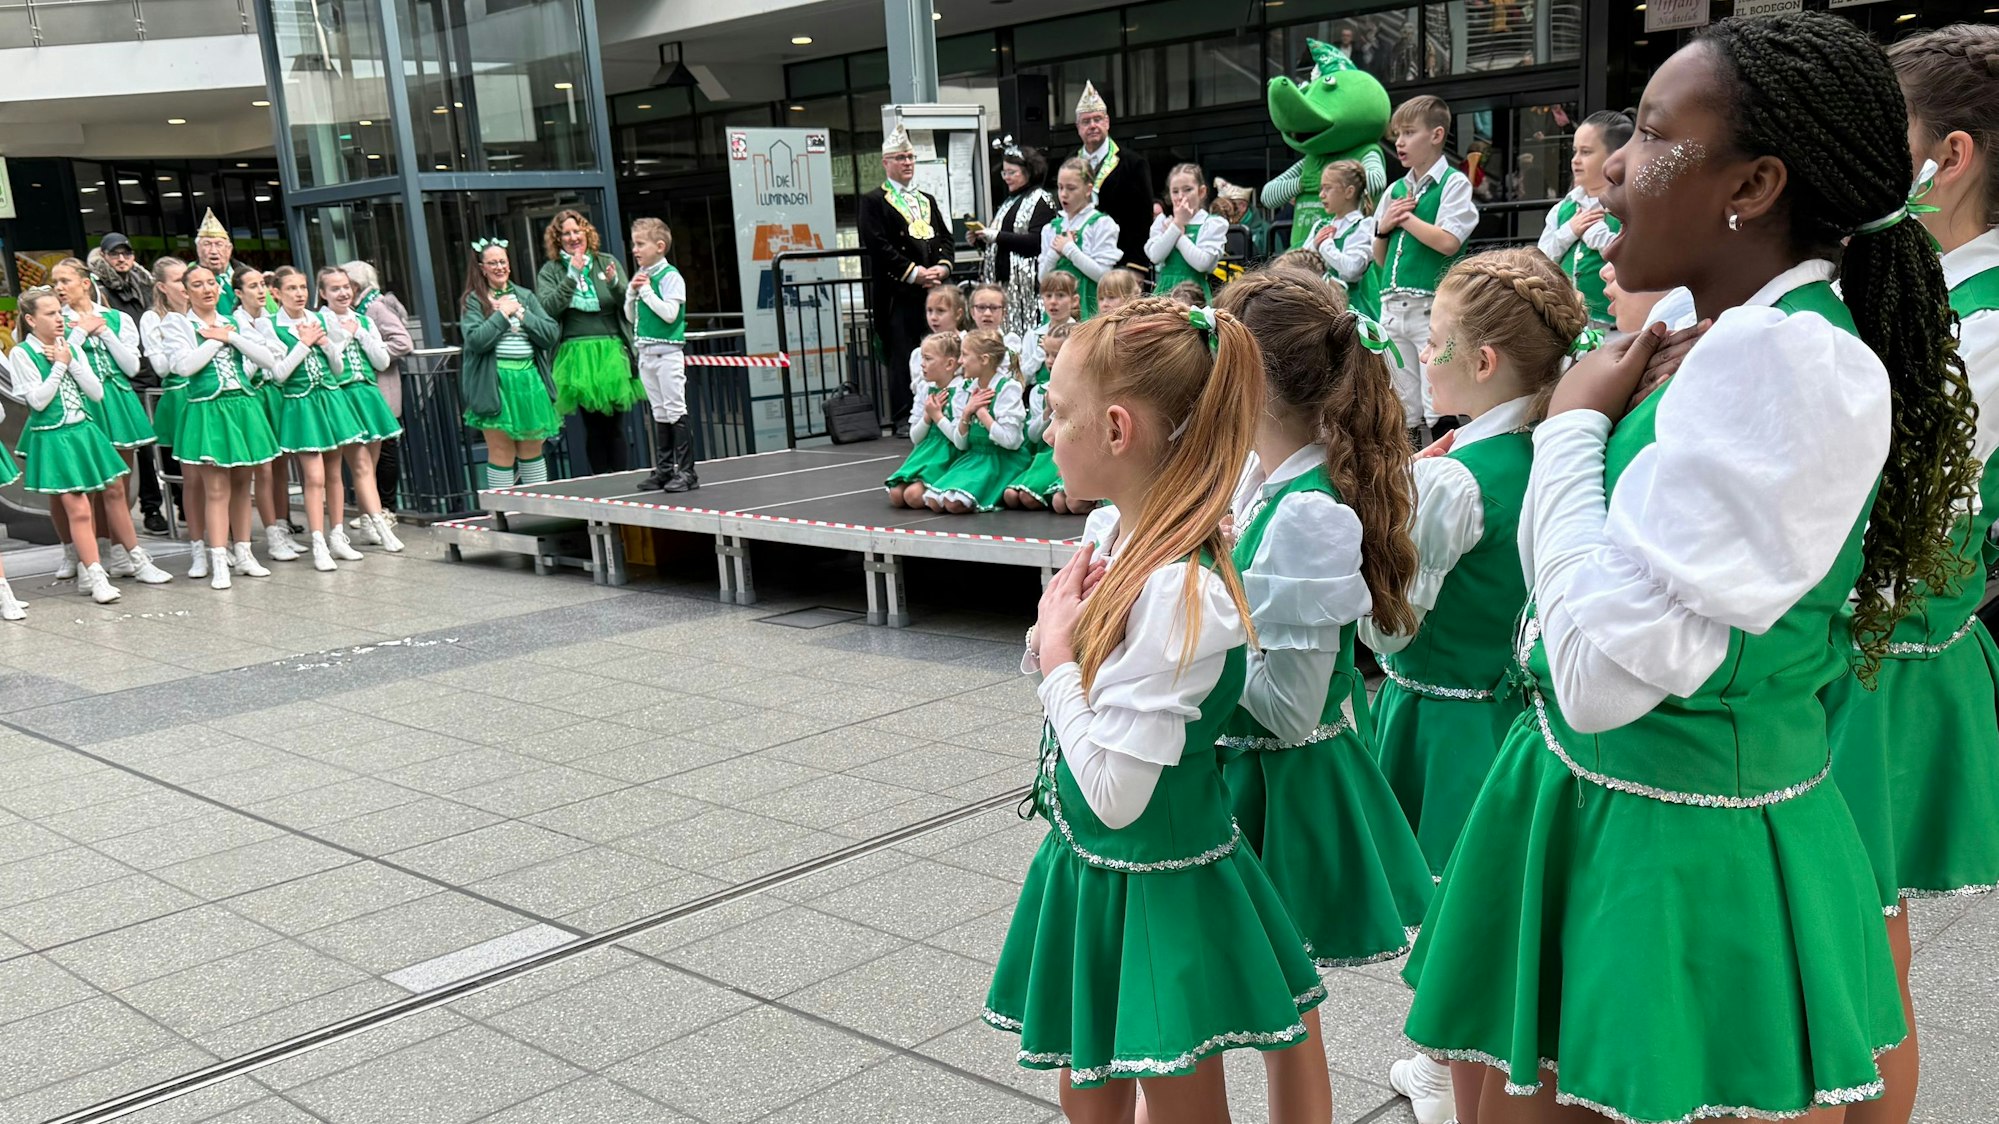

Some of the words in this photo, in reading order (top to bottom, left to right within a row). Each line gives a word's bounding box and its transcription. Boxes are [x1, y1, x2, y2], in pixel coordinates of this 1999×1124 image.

[1735, 8, 1747, 17] EL
[1750, 0, 1801, 15] BODEGON
[776, 174, 790, 188] DIE
[760, 192, 809, 206] LUMINADEN
